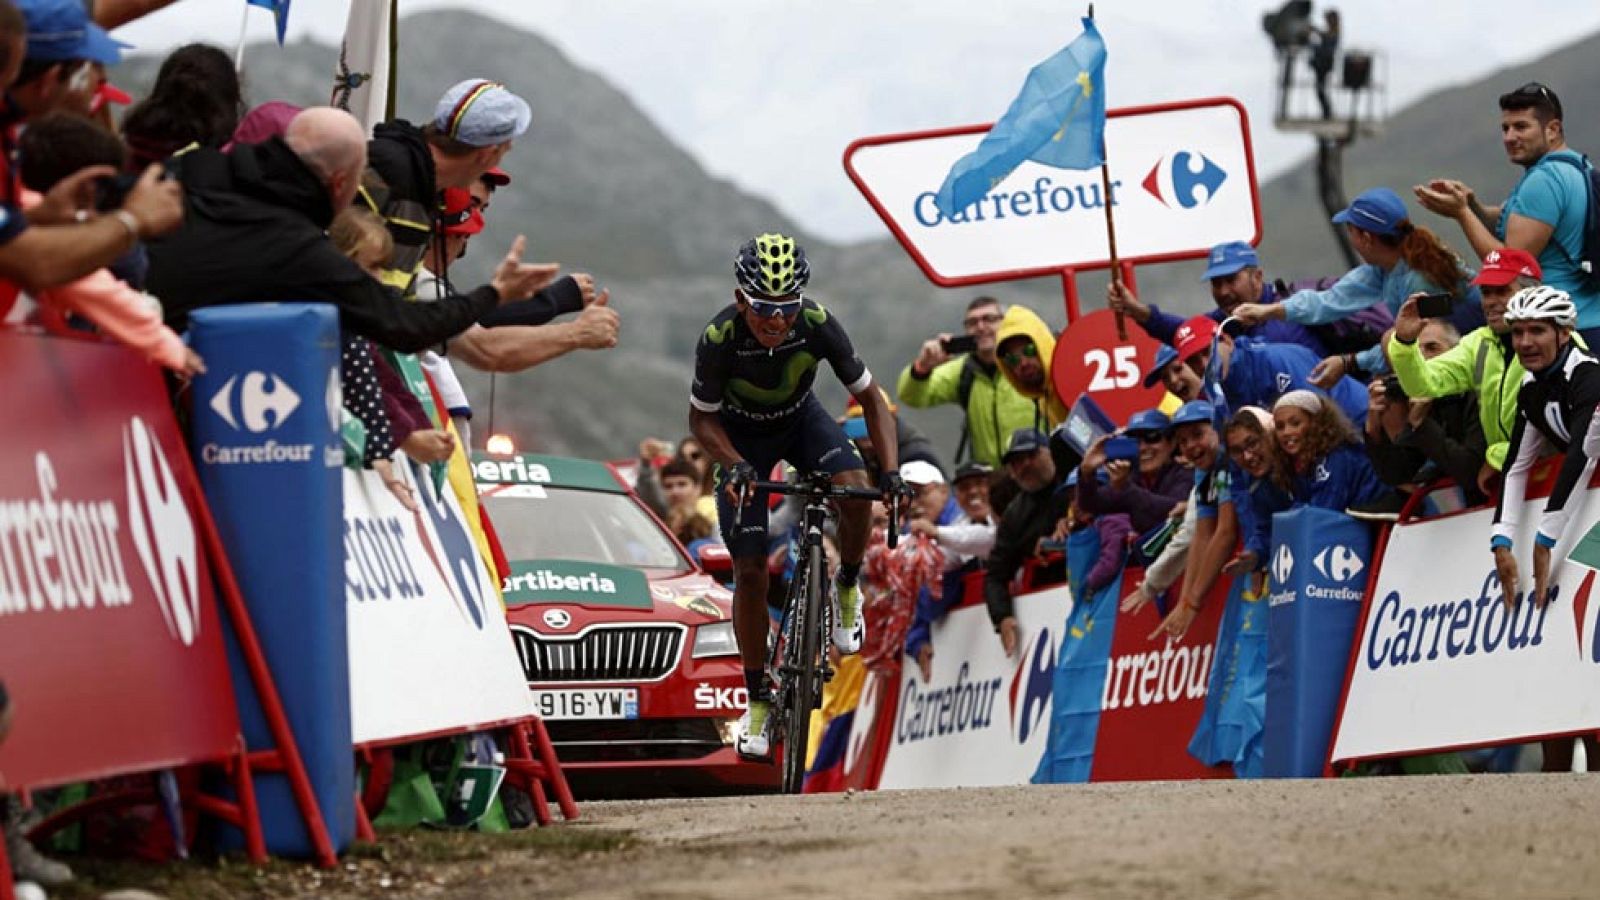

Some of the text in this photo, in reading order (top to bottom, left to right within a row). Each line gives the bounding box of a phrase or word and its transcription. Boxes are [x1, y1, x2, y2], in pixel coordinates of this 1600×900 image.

[1084, 346, 1140, 392] 25
[203, 441, 313, 464] Carrefour
[471, 456, 552, 482] eria
[0, 451, 132, 615] rrefour
[1368, 570, 1559, 671] Carrefour
[898, 662, 1001, 745] Carrefour
[1102, 634, 1213, 711] rrefou
